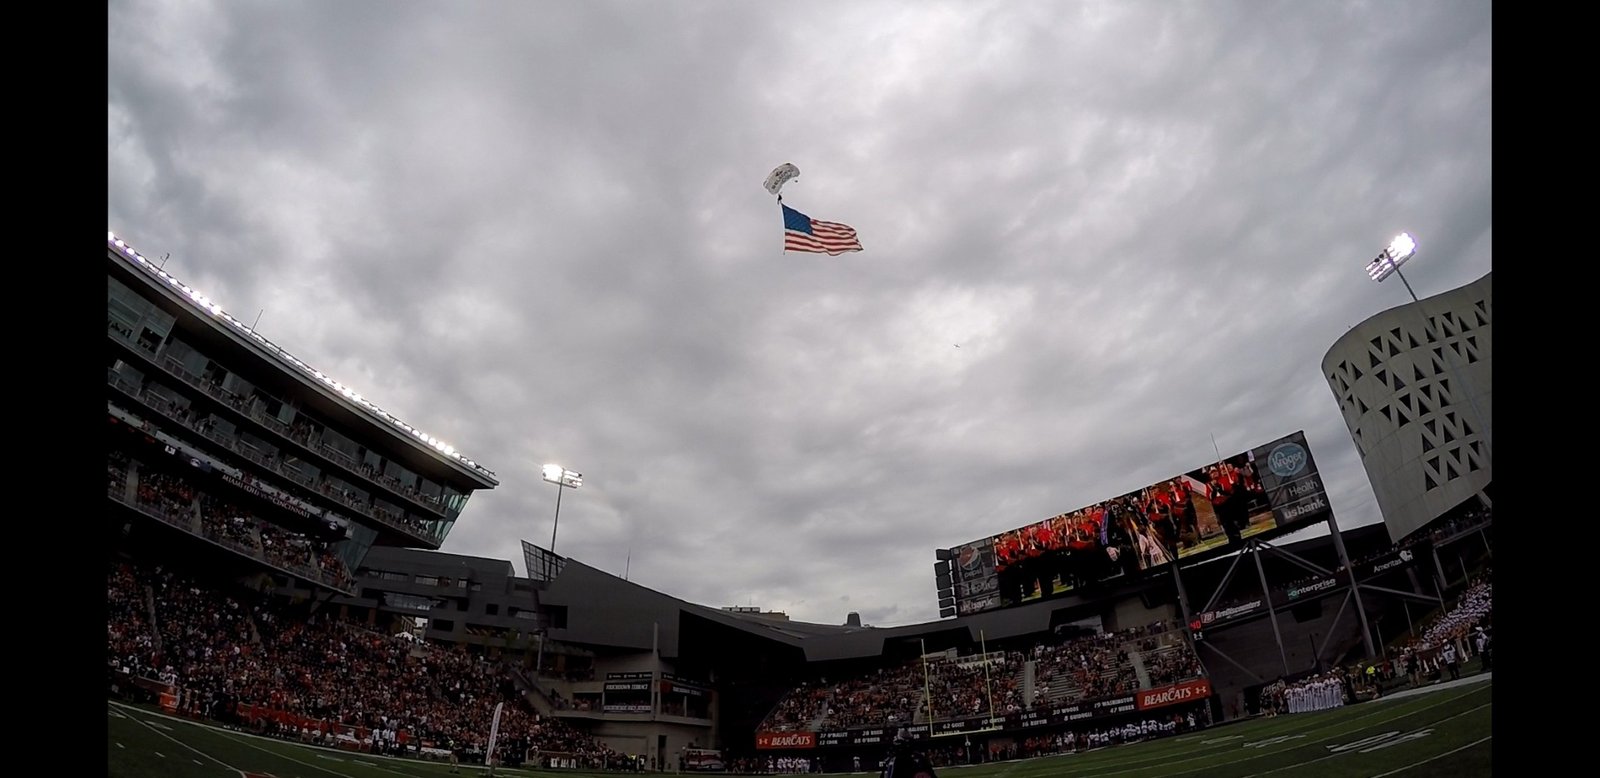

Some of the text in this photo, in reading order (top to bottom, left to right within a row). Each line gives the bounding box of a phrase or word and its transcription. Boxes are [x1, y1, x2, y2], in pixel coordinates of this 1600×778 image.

[1272, 452, 1302, 470] Kroger
[222, 474, 244, 489] MIAMI
[272, 497, 311, 519] CINCINNATI
[1288, 480, 1318, 497] Health
[1370, 558, 1401, 573] Ameritas
[1288, 578, 1334, 597] enterprise
[1143, 686, 1191, 706] BEARCATS
[771, 734, 811, 746] BEARCATS
